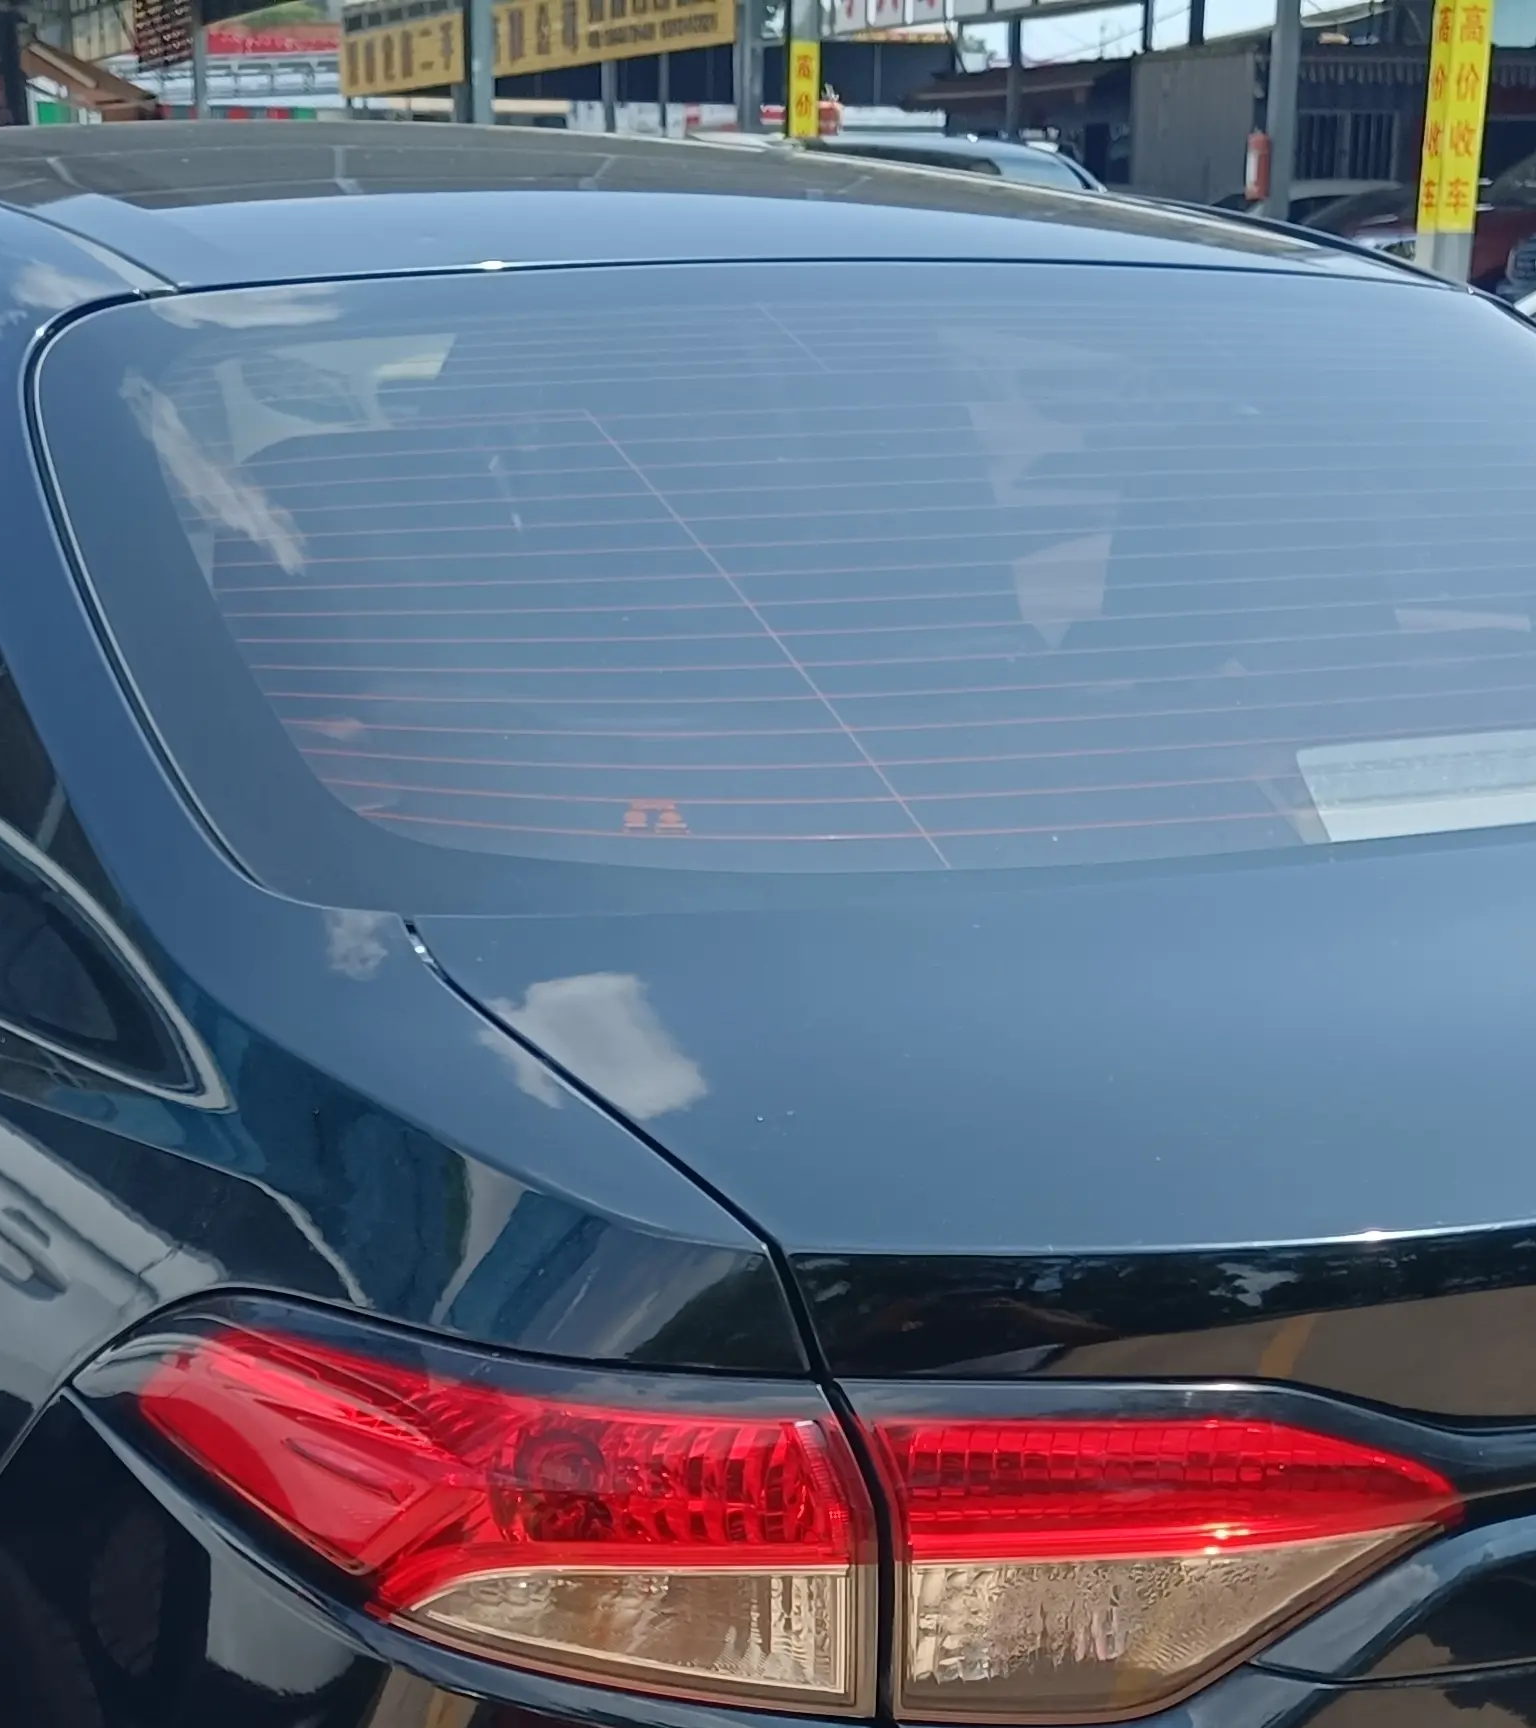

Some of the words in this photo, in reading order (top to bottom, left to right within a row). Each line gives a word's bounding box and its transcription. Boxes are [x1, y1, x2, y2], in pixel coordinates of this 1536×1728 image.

[796, 54, 814, 135] 高价
[1446, 5, 1488, 217] 高价收车
